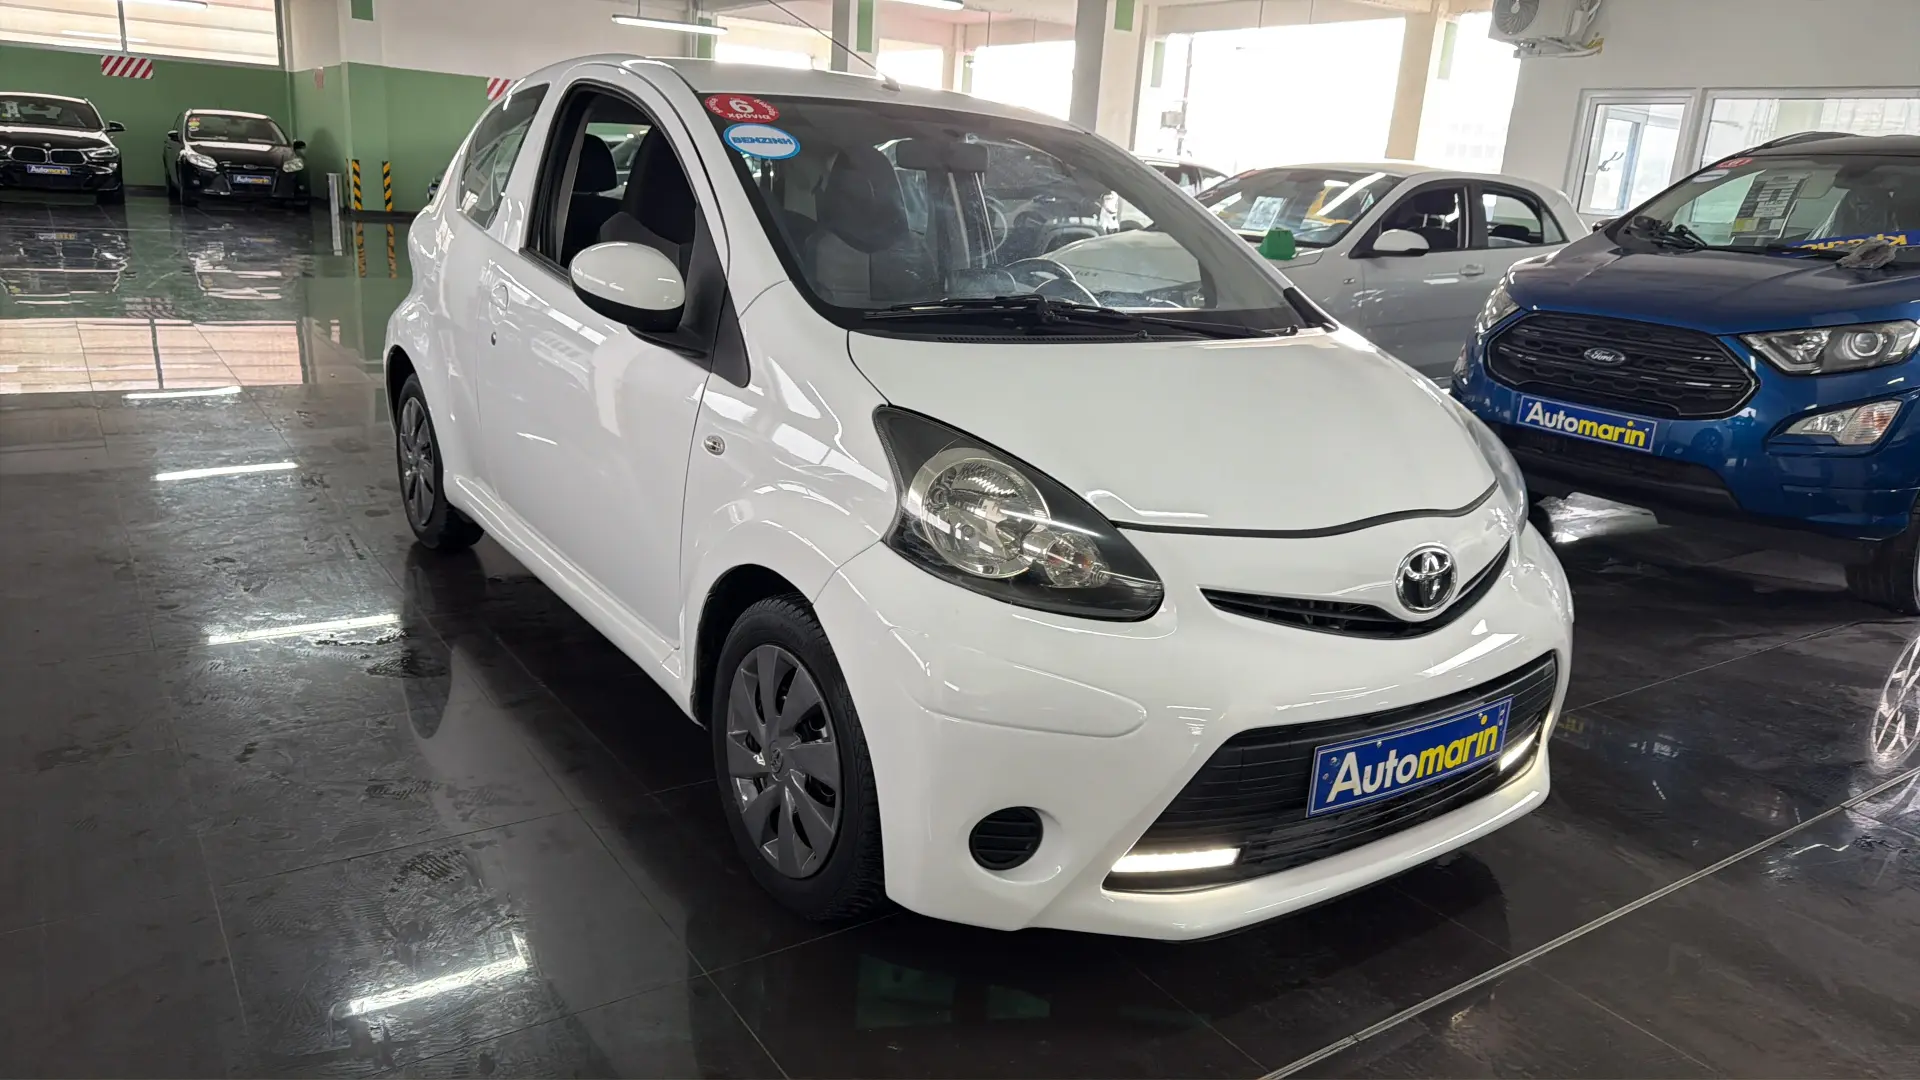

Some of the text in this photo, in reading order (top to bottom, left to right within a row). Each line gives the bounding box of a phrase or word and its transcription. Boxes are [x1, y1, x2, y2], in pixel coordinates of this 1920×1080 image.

[729, 98, 754, 114] 6
[1590, 350, 1616, 362] Ford
[1525, 401, 1646, 447] Automarin
[1326, 714, 1498, 803] Automarin
